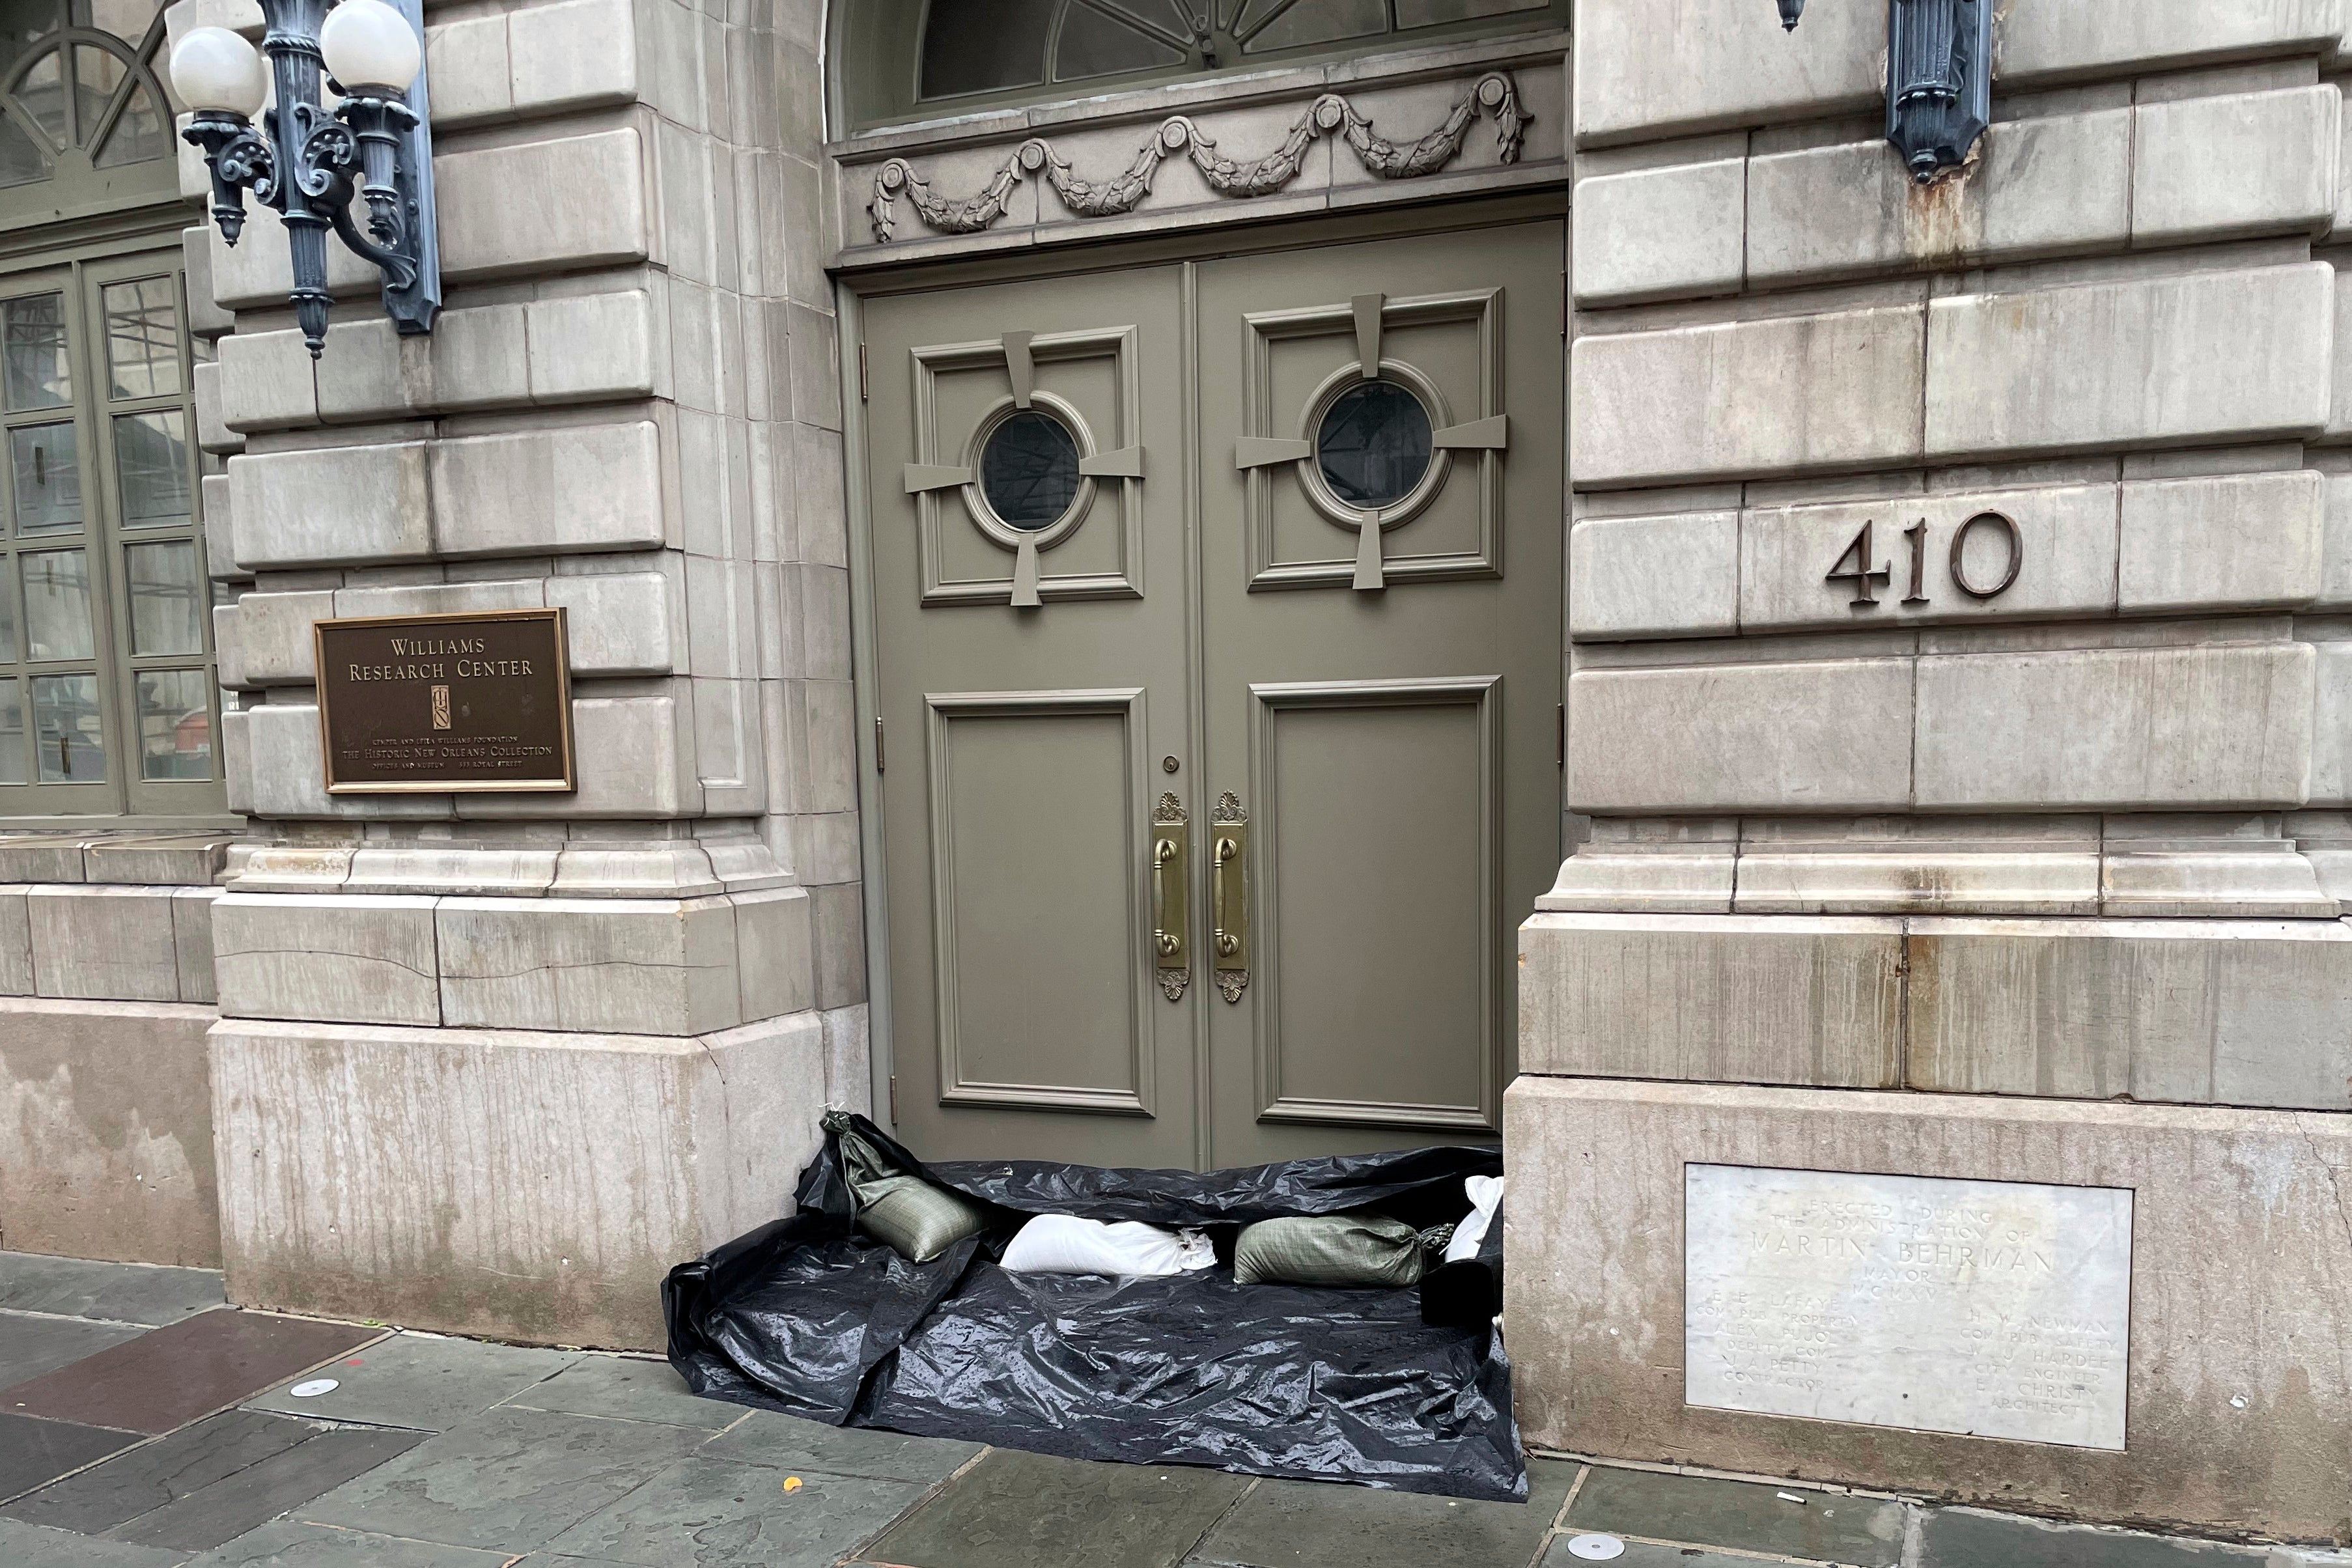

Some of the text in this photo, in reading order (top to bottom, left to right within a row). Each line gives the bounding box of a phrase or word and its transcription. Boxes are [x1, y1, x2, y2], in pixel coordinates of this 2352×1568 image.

[1825, 509, 2023, 604] 410
[391, 638, 485, 656] WILLIAMS
[350, 659, 533, 681] RESEARCH CENTER
[473, 736, 518, 744] FOUNDATION
[343, 746, 553, 759] THE HISTORIC NEW ORLEANS COLLECTION
[1810, 1199, 1993, 1224] ERECTED DURING
[1771, 1214, 2030, 1242] THE ADMINISTRATION OF
[1750, 1231, 2052, 1271] MARTIN BEHRMAN
[1864, 1266, 1935, 1284] MAYOR
[1771, 1293, 1838, 1311] LAFAYE
[1782, 1312, 1858, 1328] PROPERTY
[2027, 1315, 2110, 1334] NEWMAN
[1714, 1322, 1838, 1344] ALEX PUJOL
[1728, 1339, 1784, 1354] DEPUTY
[2056, 1335, 2117, 1351] SAFETY
[1771, 1358, 1822, 1375] PETTY
[2033, 1349, 2110, 1369] HARDEE
[1724, 1370, 1826, 1390] CONTRACTOR
[1975, 1364, 2103, 1385] CITY ENGINEER
[2018, 1382, 2101, 1401] CHRISTY
[1991, 1397, 2081, 1415] ARCHITECT
